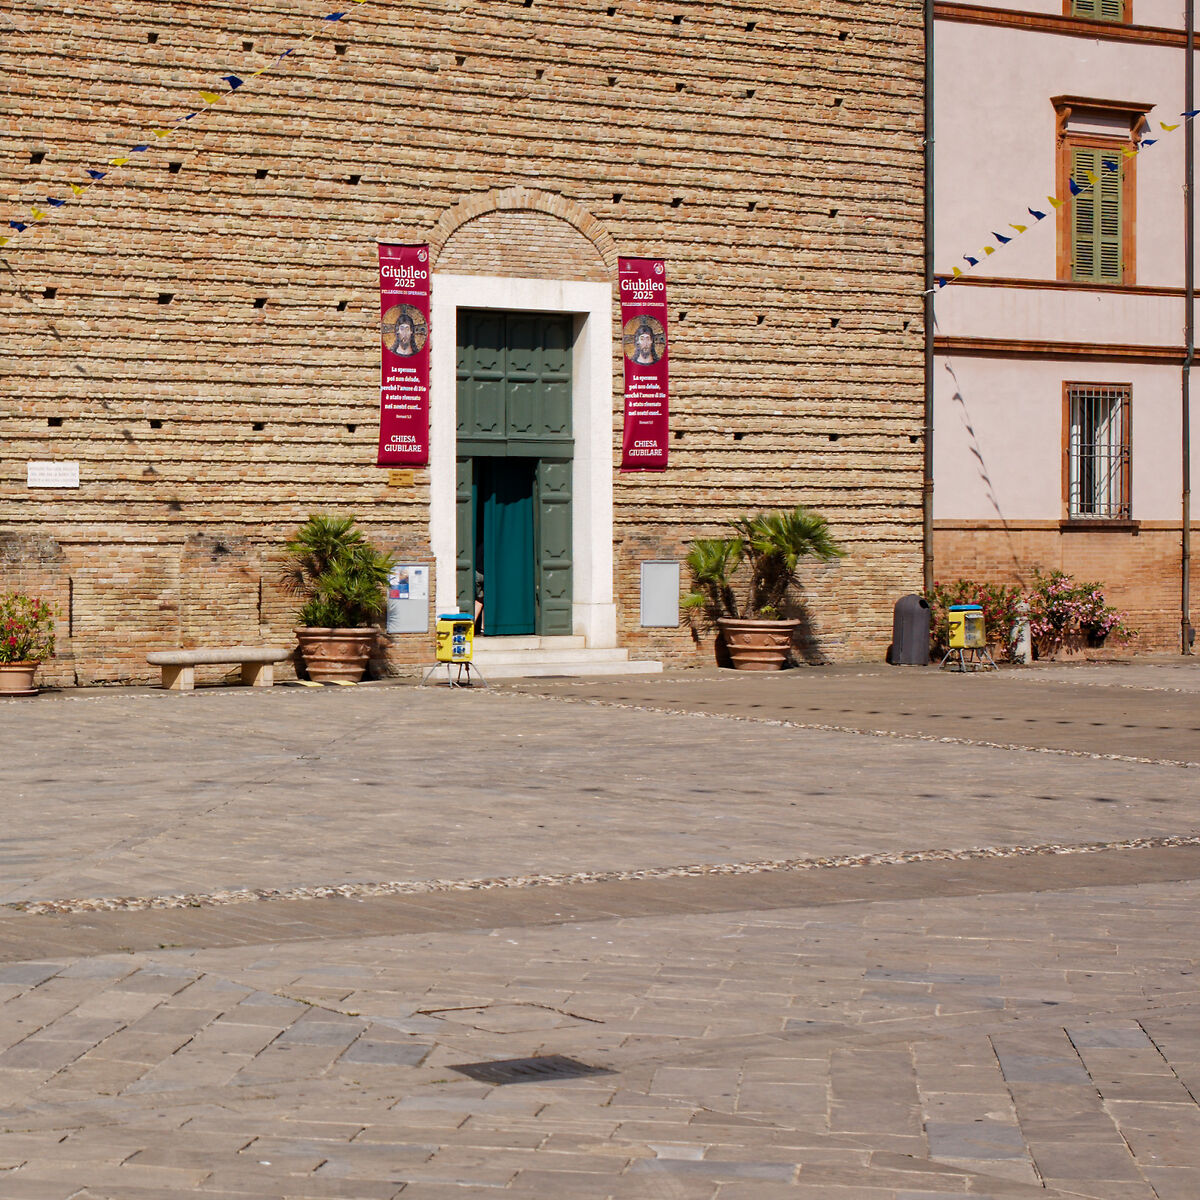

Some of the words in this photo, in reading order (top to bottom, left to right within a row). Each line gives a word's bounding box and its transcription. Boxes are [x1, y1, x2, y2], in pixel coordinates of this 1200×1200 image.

[381, 265, 427, 279] Giubileo
[394, 278, 416, 288] 2025
[621, 278, 664, 291] Giubileo
[632, 291, 654, 300] 2025
[391, 435, 416, 443] CHIESA
[384, 444, 422, 453] GIUBILARE
[634, 440, 657, 448] CHIESA
[628, 449, 662, 457] GIUBILARE
